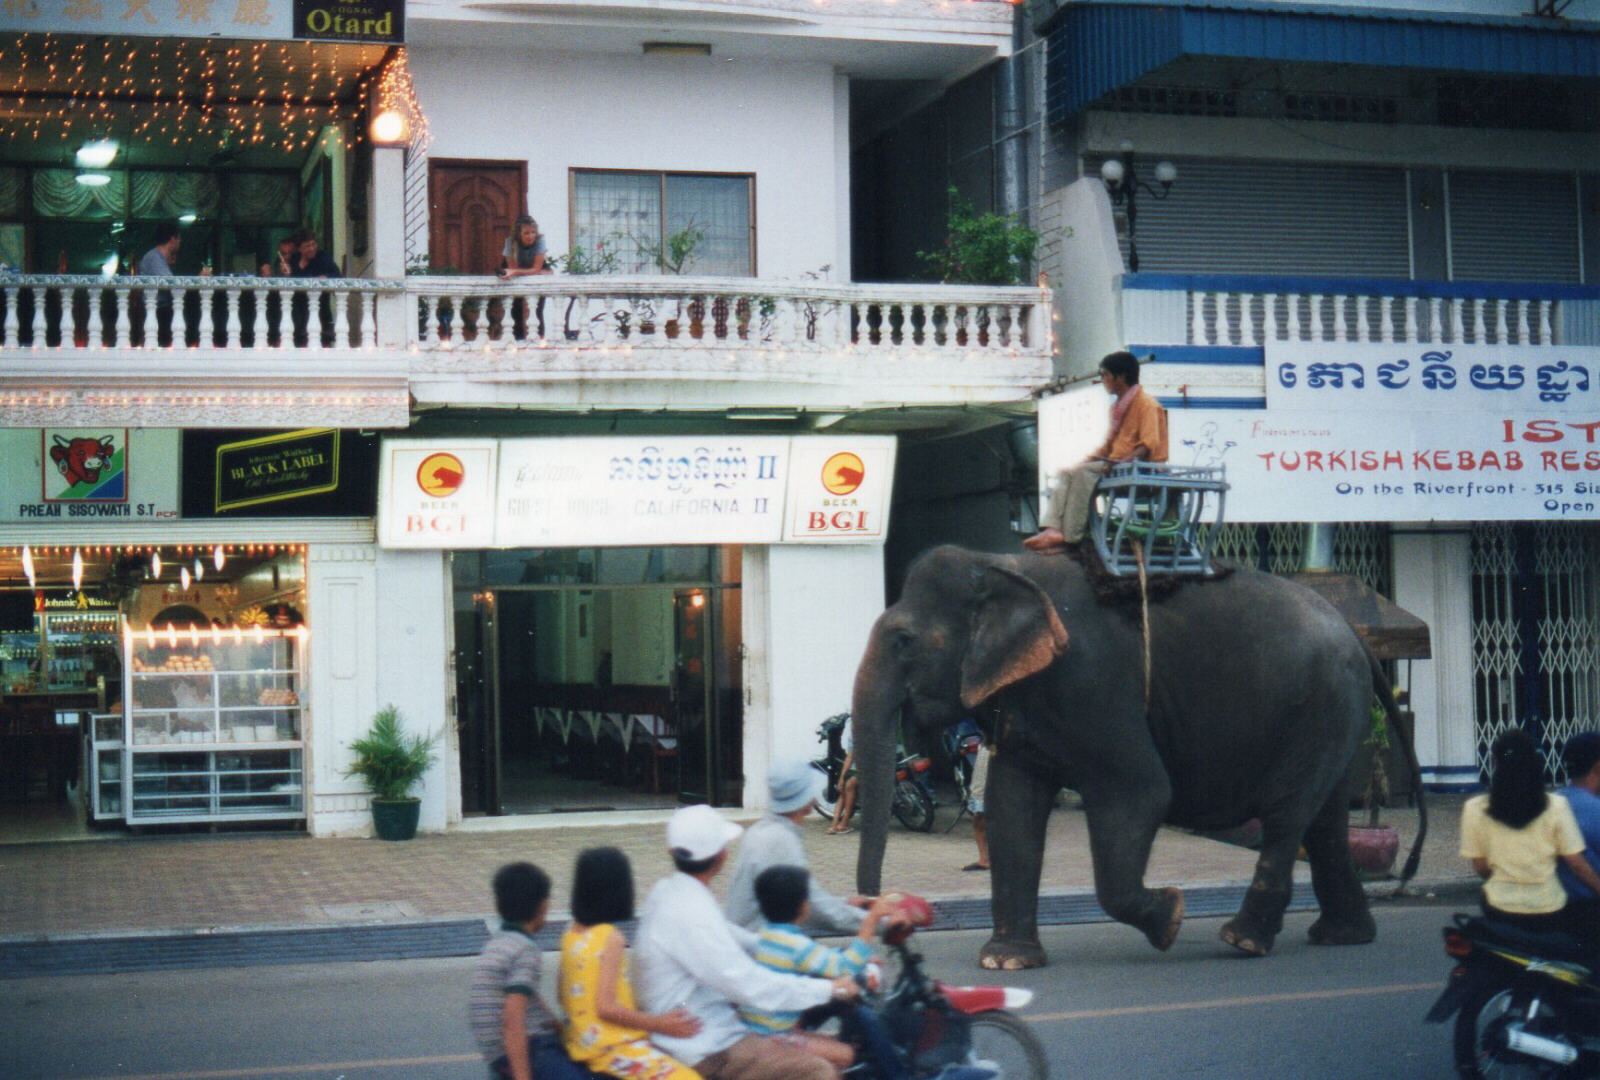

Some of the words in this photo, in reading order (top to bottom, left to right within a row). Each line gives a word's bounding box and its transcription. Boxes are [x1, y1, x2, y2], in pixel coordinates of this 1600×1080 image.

[306, 9, 393, 35] Otard
[1278, 350, 1600, 403] ភោជនីយដ្ឋា
[231, 462, 278, 480] BLACK
[281, 453, 328, 472] LABEL
[756, 455, 777, 480] II
[1256, 450, 1404, 472] TURKISH
[1412, 450, 1524, 472] KEBAB
[1540, 450, 1600, 472] RES
[1335, 482, 1364, 496] On
[1373, 482, 1404, 496] the
[1413, 482, 1515, 498] Riverfront
[1534, 482, 1564, 495] 315
[20, 503, 61, 517] PREAH
[68, 503, 131, 517] SISOWATH
[634, 498, 740, 516] CALIFORNIA
[753, 497, 769, 514] II
[1543, 499, 1595, 515] Open
[807, 510, 871, 532] BGI
[44, 598, 77, 607] Johnnie
